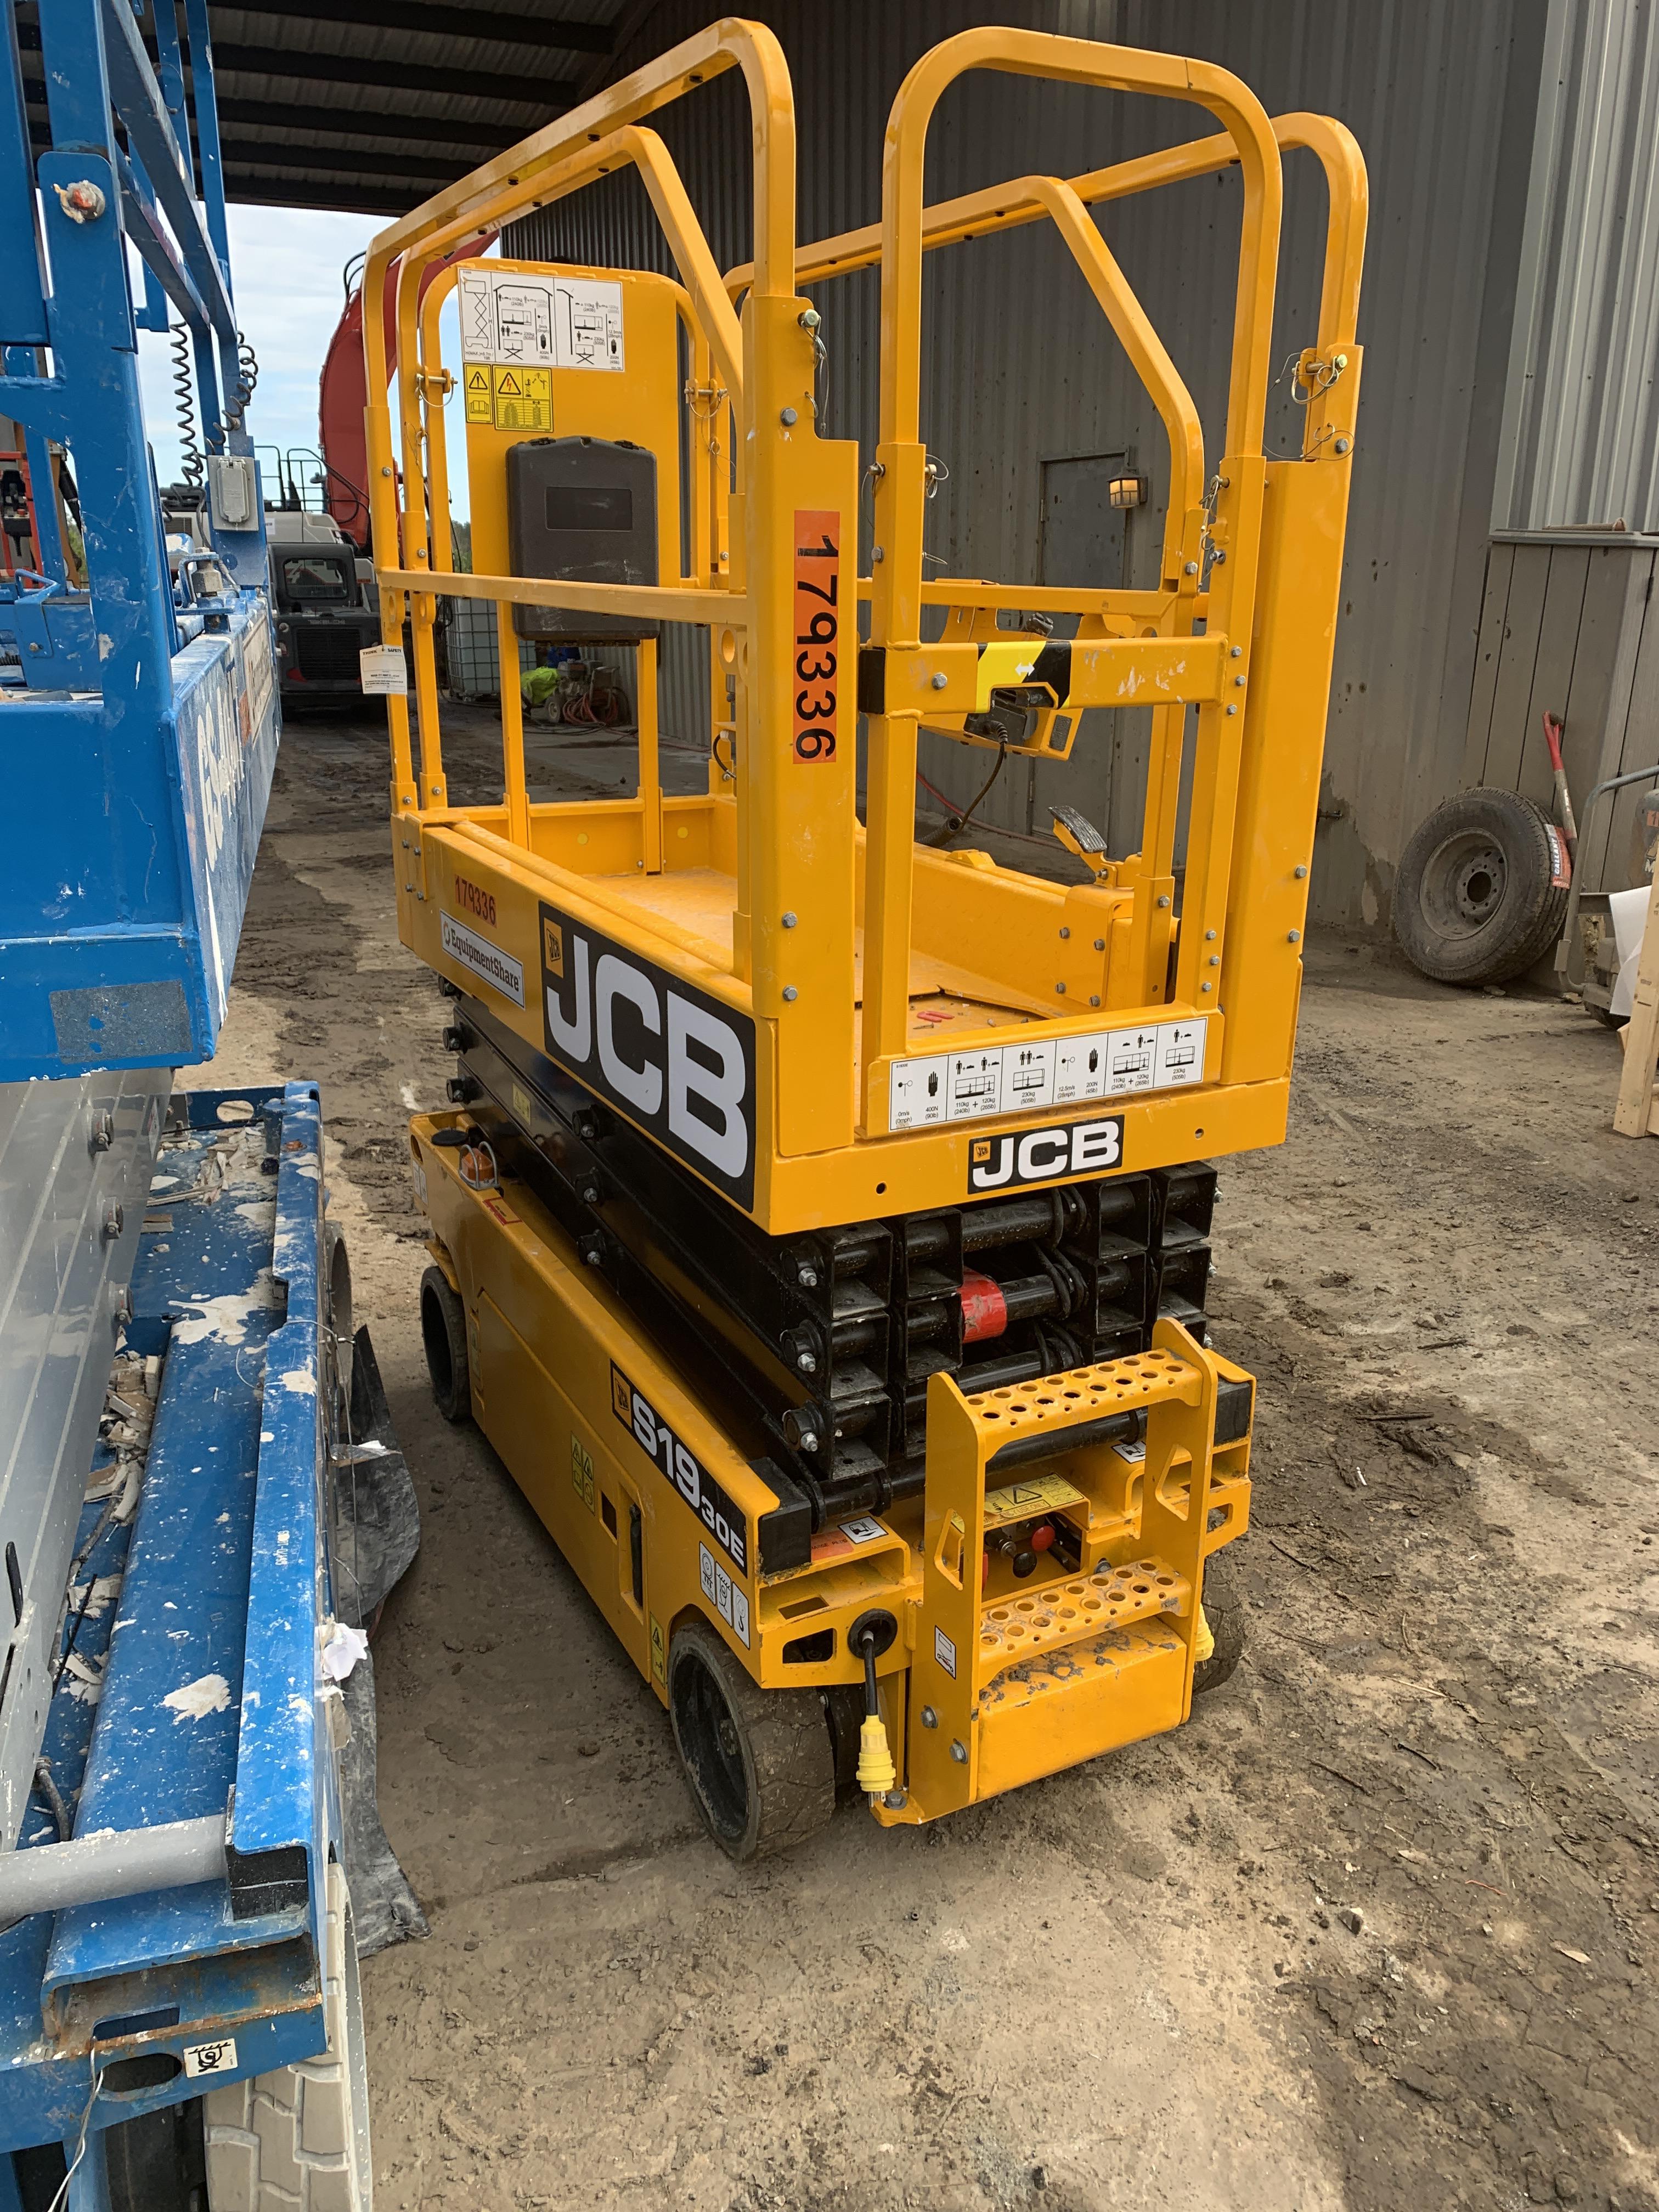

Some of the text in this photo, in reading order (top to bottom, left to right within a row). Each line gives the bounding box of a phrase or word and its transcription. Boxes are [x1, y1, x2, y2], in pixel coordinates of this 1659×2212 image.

[796, 535, 839, 759] 179336
[1551, 837, 1560, 874] GALLANT
[455, 876, 495, 925] 179336
[451, 928, 519, 992] EquipmentShare
[547, 935, 747, 1177] JCB
[895, 1116, 912, 1125] (0mph)
[973, 1121, 1119, 1187] JCB
